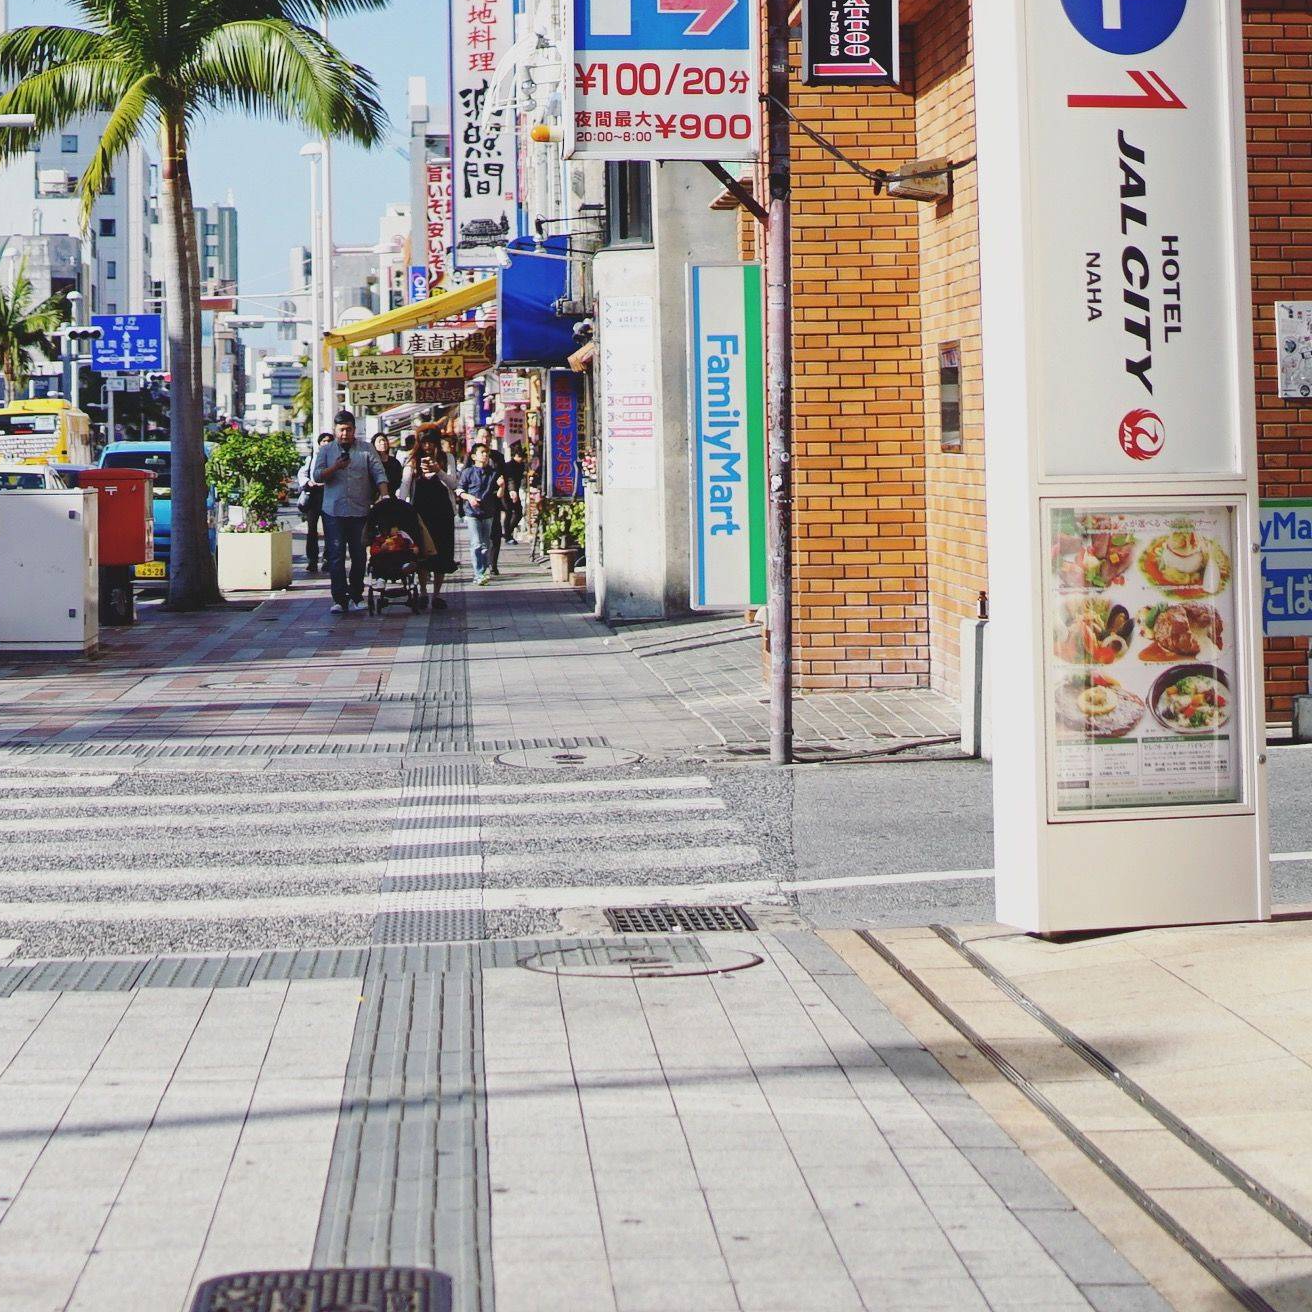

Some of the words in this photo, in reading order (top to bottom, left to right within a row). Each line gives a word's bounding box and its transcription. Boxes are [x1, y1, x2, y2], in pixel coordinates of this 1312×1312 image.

[575, 110, 652, 128] 夜間最大
[654, 113, 752, 140] ¥900
[1085, 252, 1103, 322] NAHA
[1161, 235, 1182, 343] HOTEL
[365, 359, 414, 375] 海ぶどう
[407, 332, 485, 355] 産直市場
[702, 334, 742, 537] FamilyMart
